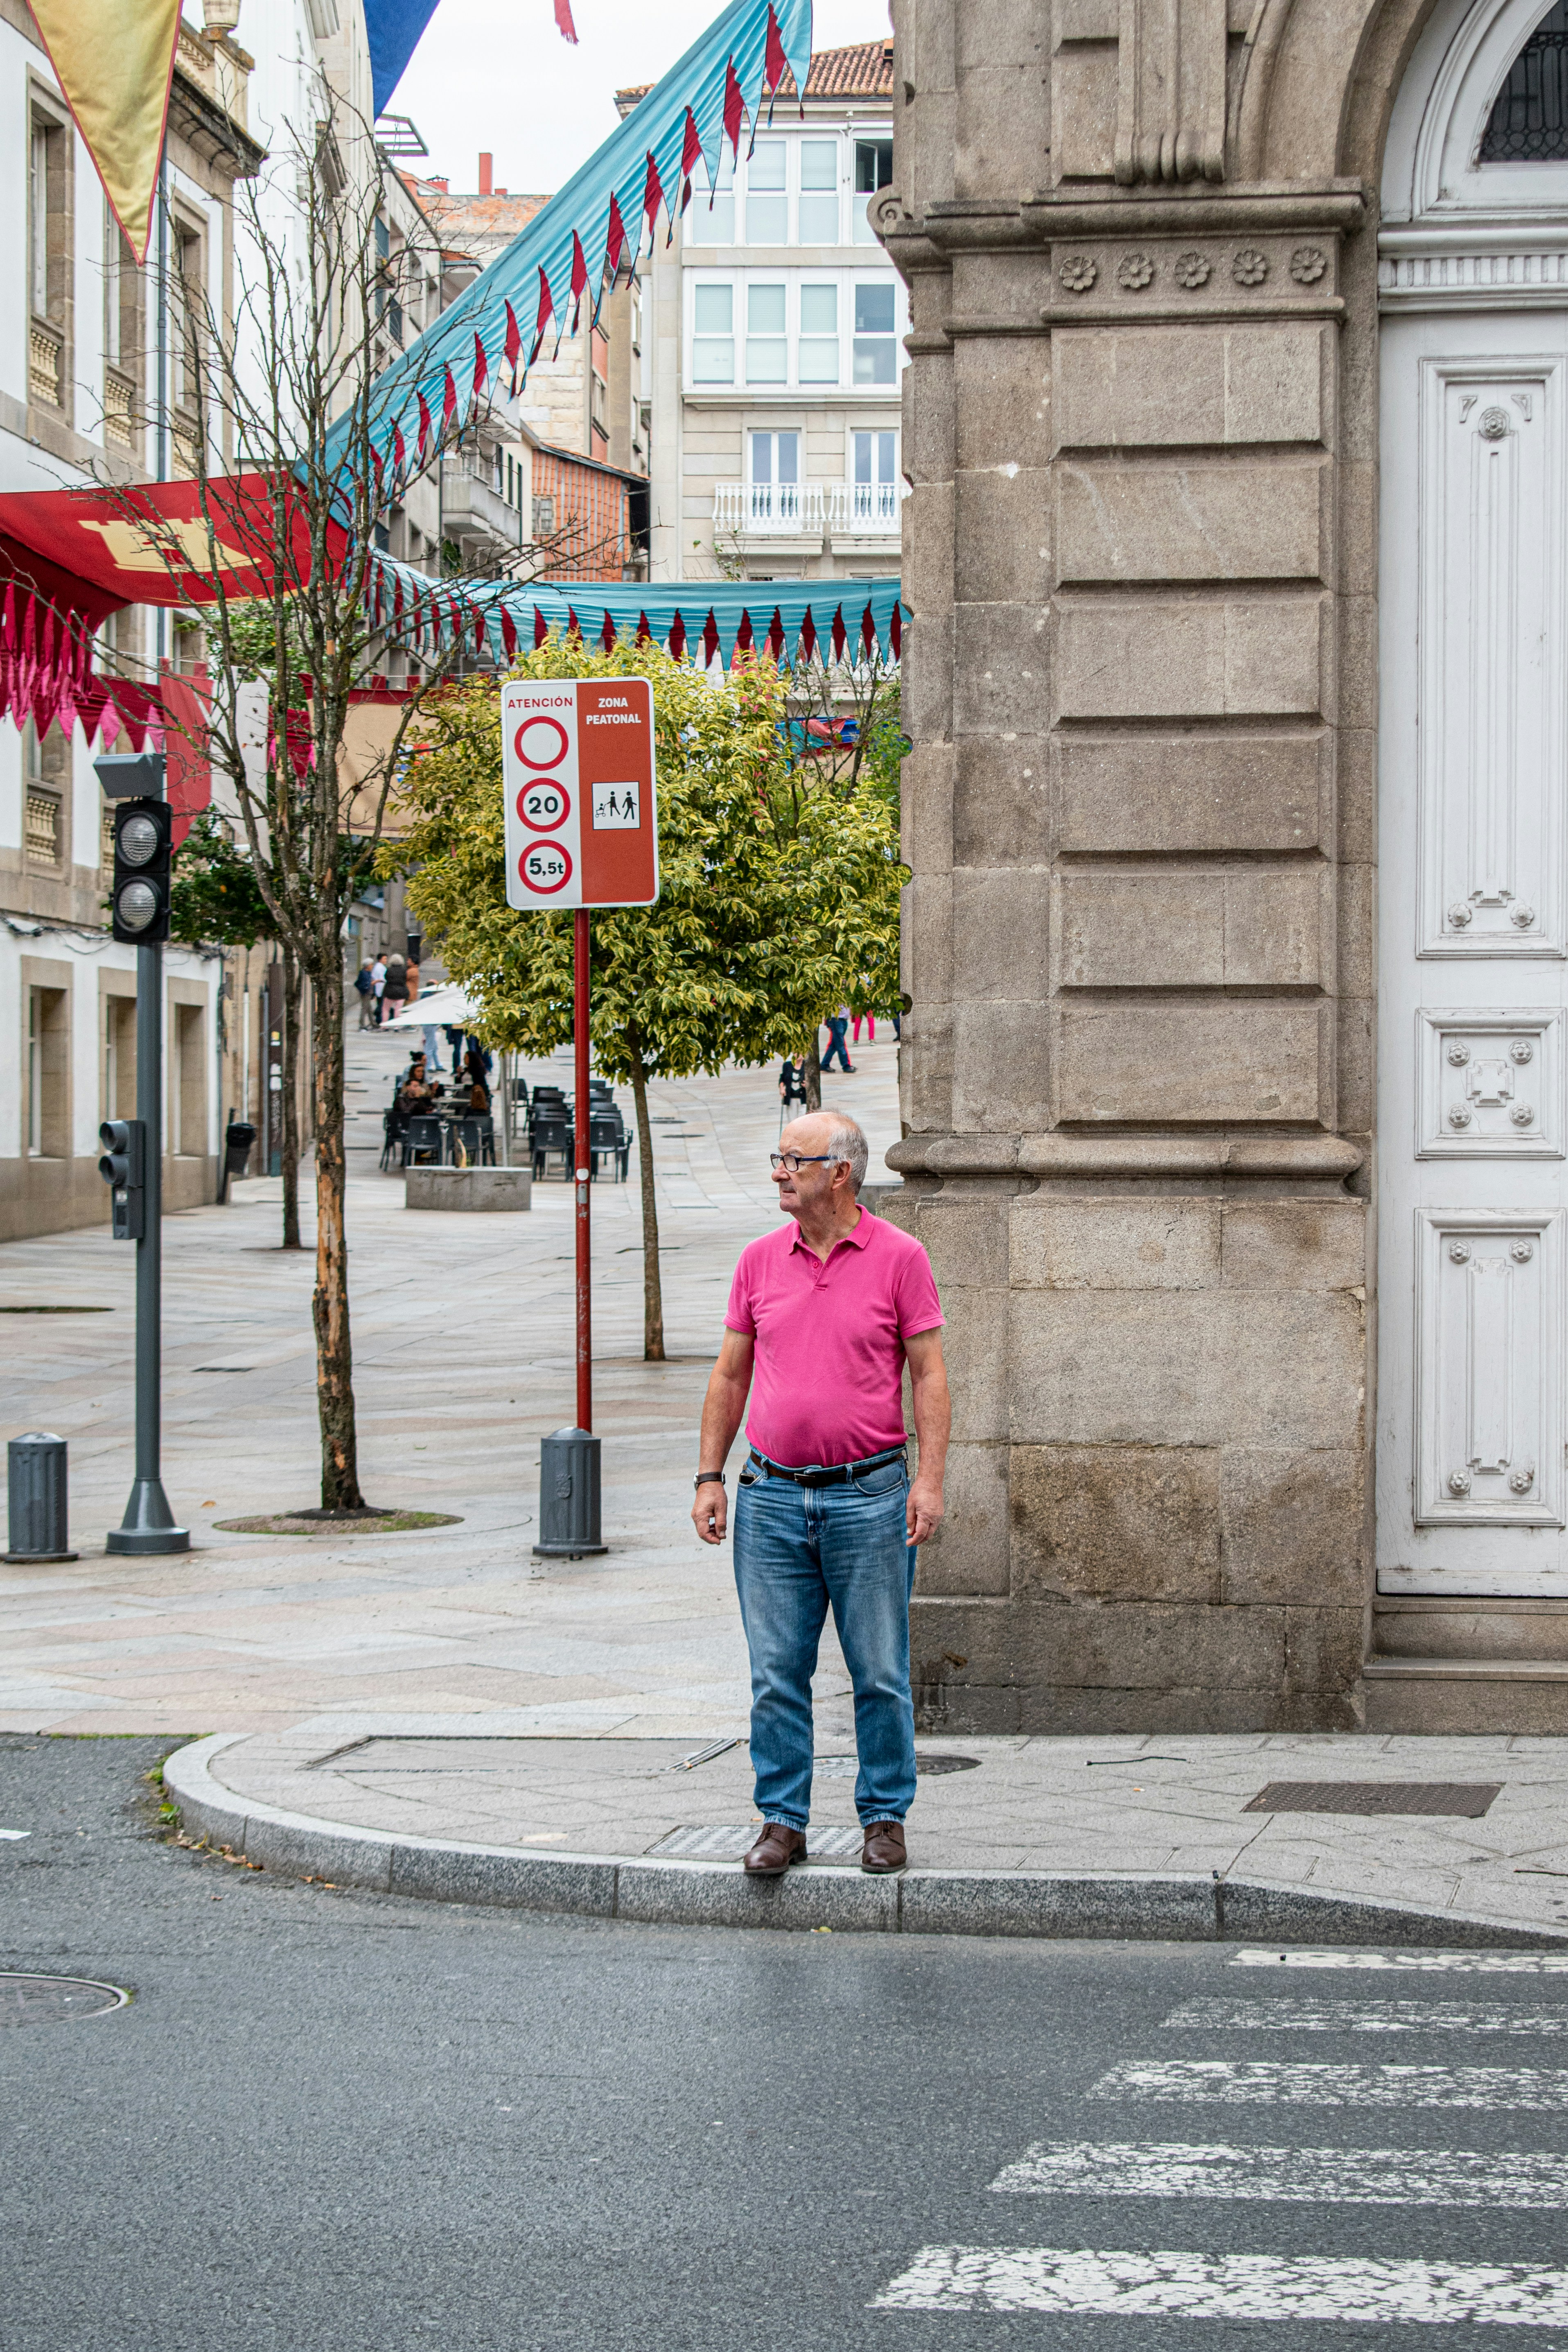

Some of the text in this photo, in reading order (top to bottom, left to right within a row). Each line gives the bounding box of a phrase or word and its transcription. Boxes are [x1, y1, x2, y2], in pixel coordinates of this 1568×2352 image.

[508, 696, 573, 708] ATENCIÓN
[598, 697, 628, 708] ZONA
[586, 713, 641, 725] PEATONAL
[528, 796, 558, 814] 20
[529, 858, 564, 876] 5,5t
